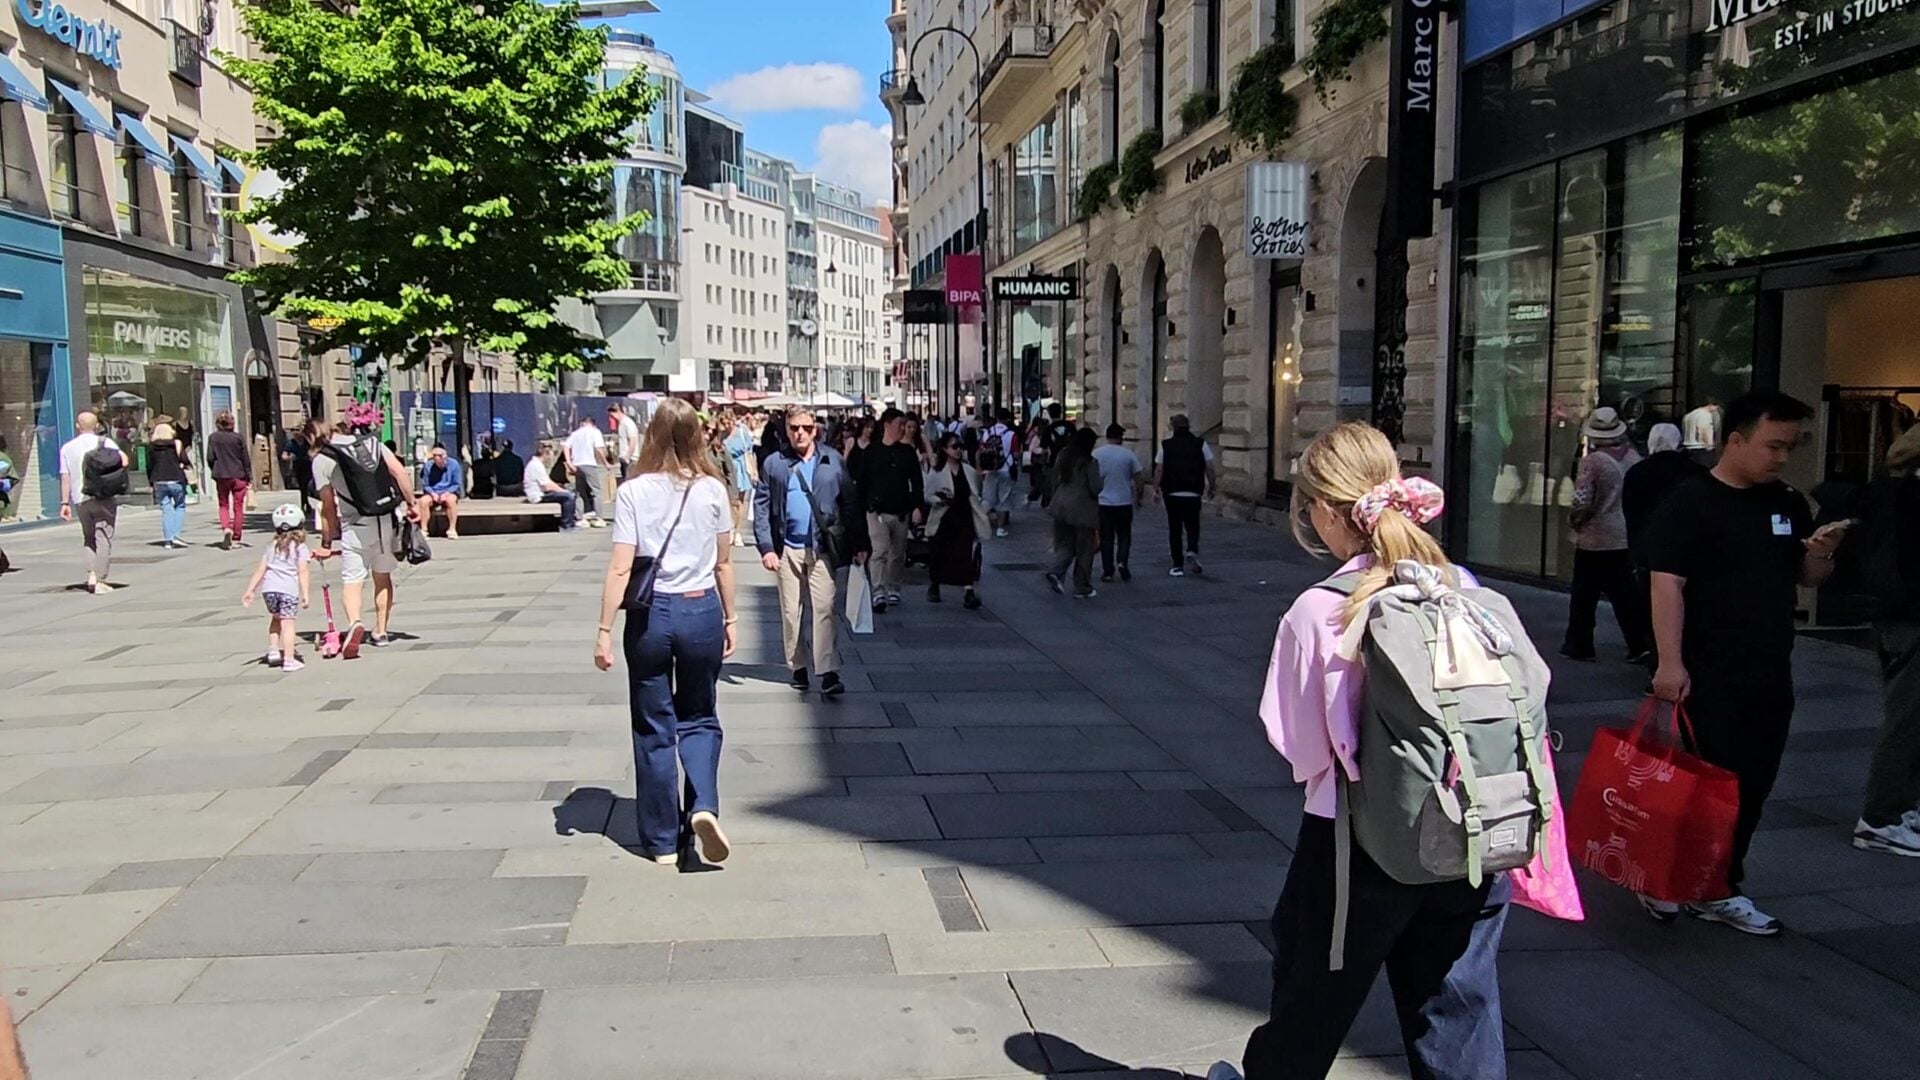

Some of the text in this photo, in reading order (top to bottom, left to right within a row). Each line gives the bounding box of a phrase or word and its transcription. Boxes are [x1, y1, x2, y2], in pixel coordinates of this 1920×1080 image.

[1774, 21, 1809, 49] EST.
[1816, 10, 1834, 37] IN
[1842, 0, 1910, 25] STOC
[1407, 17, 1432, 112] Marc
[1250, 216, 1309, 238] & other
[1252, 235, 1305, 256] Stories
[949, 290, 981, 302] BIPA
[998, 281, 1071, 296] HUMANIC
[114, 320, 191, 350] PALMERS
